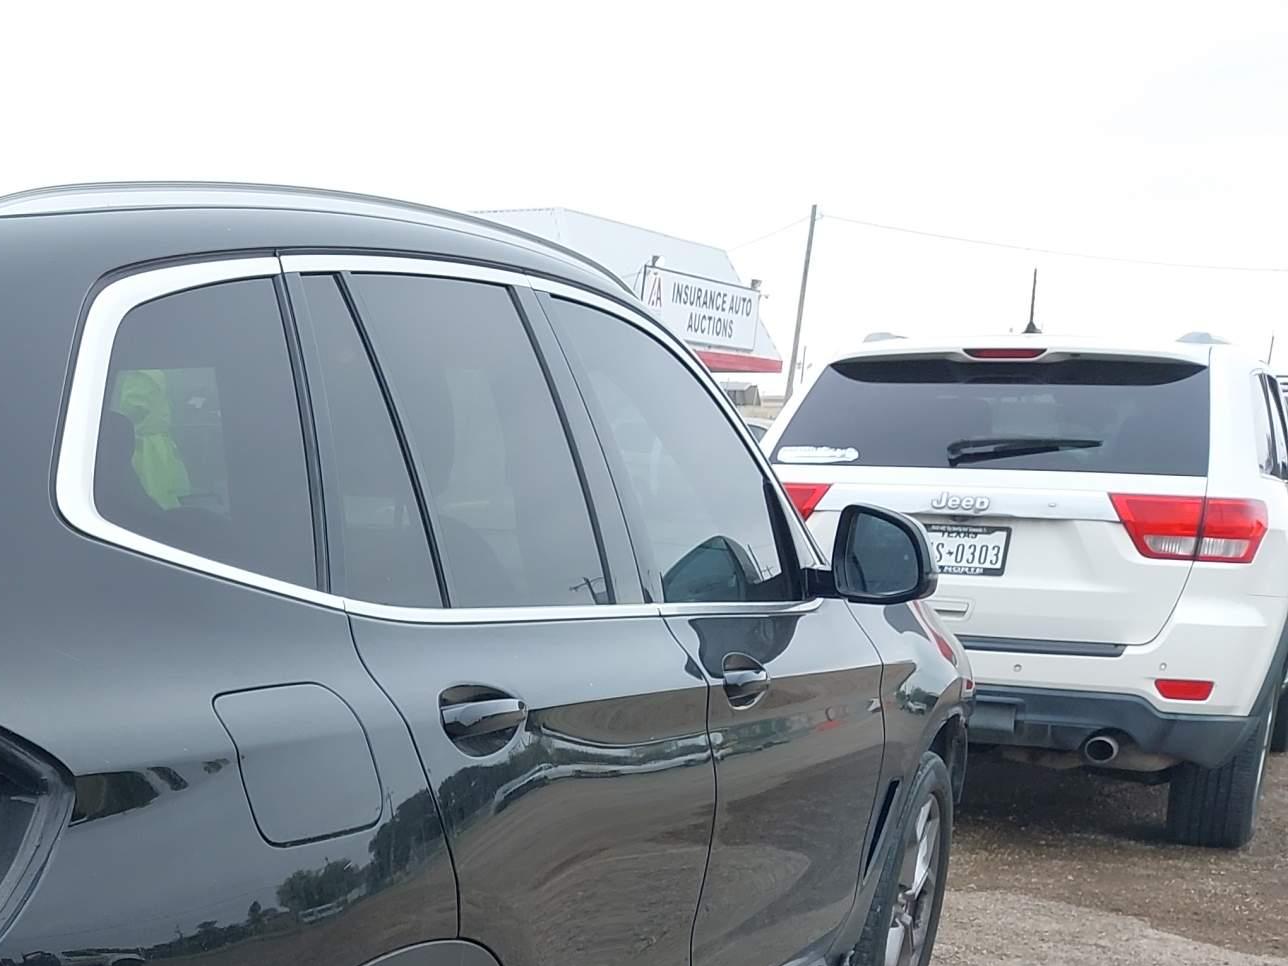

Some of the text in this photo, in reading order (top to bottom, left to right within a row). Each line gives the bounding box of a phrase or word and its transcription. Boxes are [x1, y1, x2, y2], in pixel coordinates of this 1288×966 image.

[672, 282, 753, 317] INSURANCE AUTO
[687, 311, 734, 338] AUCTIONS
[931, 491, 990, 514] Jeep
